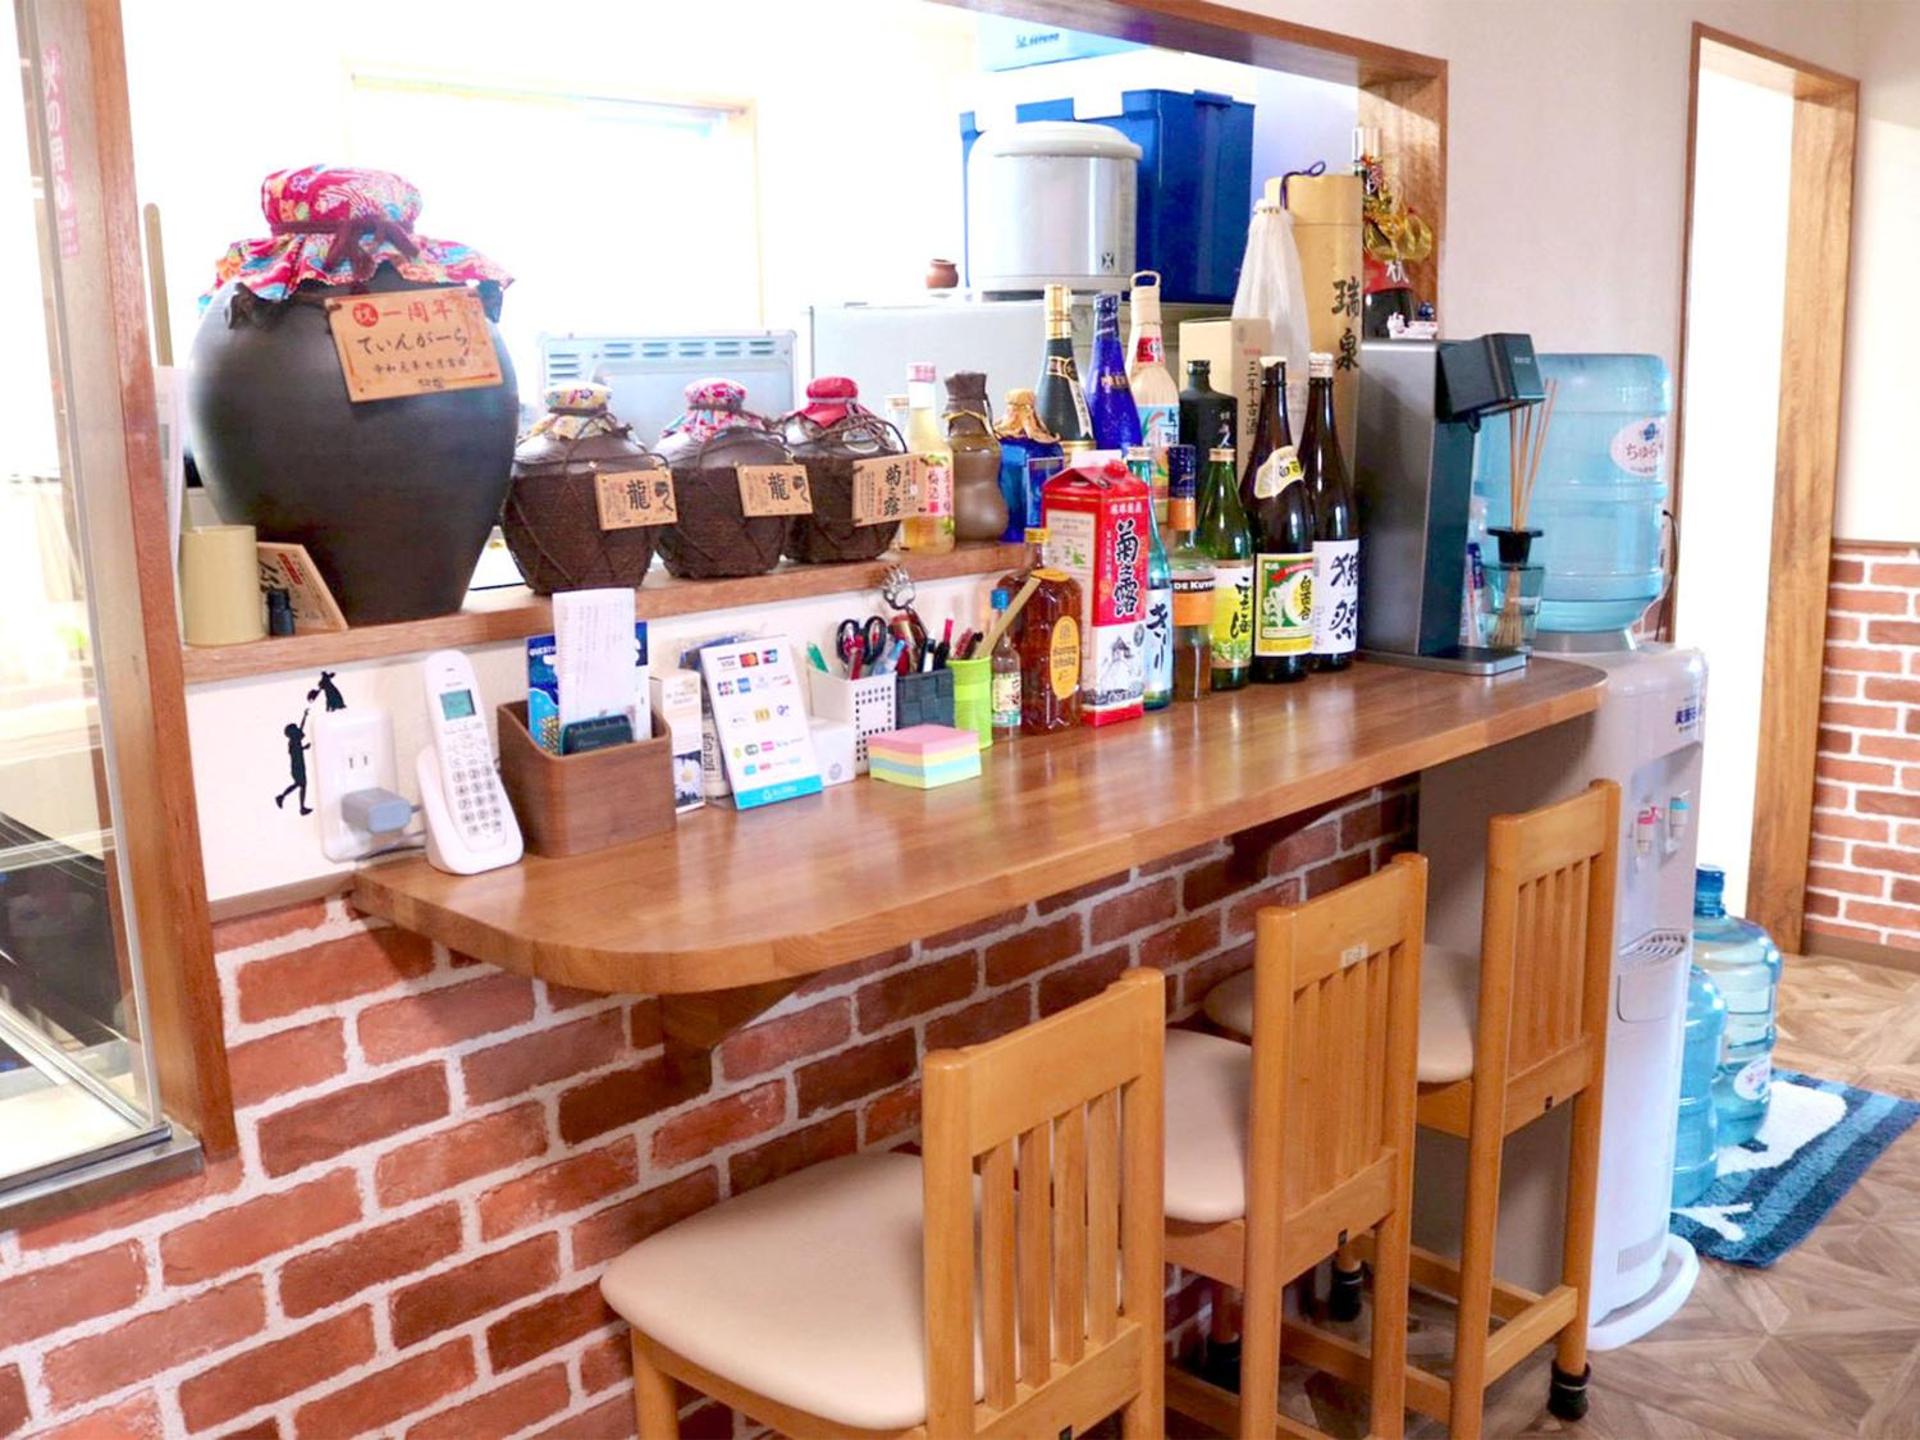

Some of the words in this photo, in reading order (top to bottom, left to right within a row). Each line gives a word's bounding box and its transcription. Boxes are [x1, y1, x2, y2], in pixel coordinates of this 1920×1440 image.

[1331, 275, 1360, 372] 瑞泉
[626, 479, 651, 510] 龍
[767, 472, 790, 501] 龍
